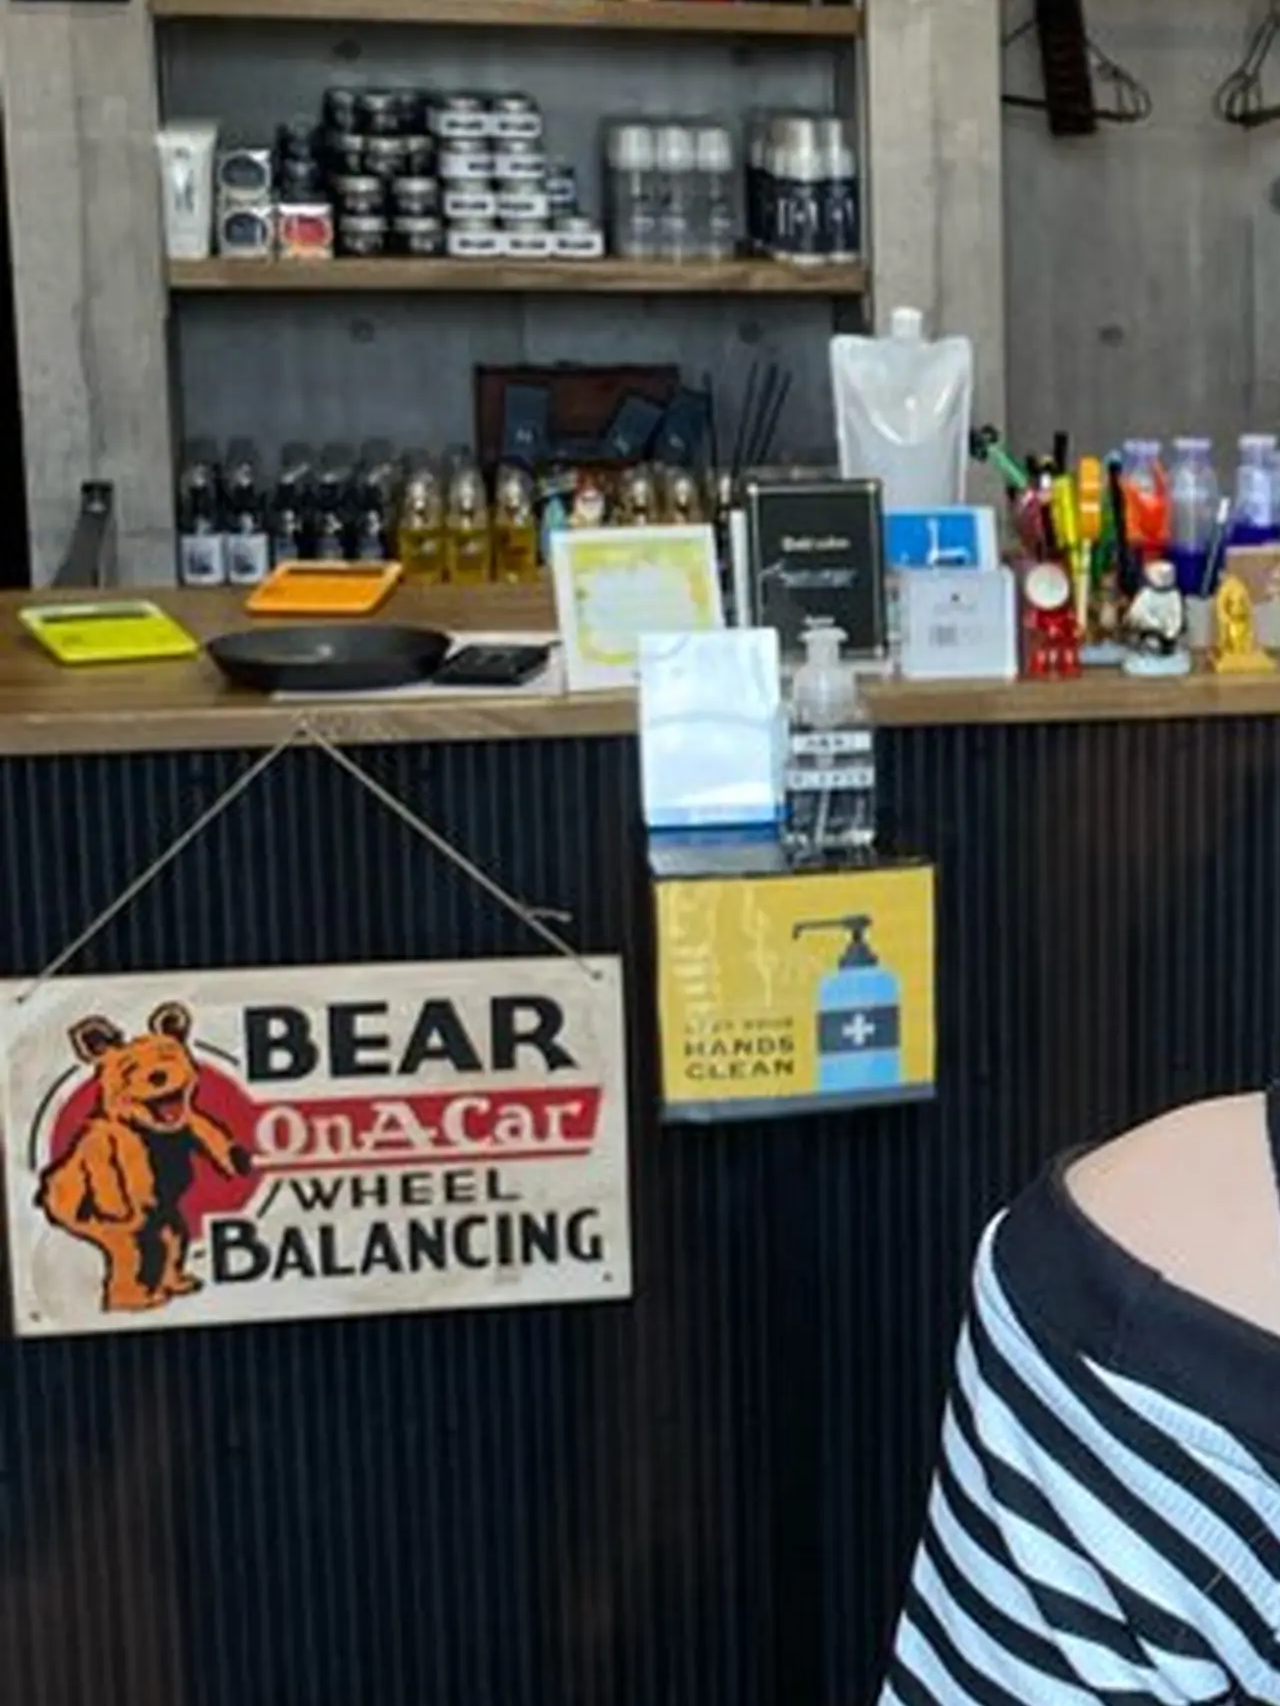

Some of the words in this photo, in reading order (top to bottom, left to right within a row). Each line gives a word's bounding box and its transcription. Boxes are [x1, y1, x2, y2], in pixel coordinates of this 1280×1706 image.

[244, 995, 578, 1083] BEAR
[684, 1035, 795, 1057] HANDS
[684, 1058, 795, 1080] CLEAN
[289, 1167, 524, 1212] WHEEL
[210, 1207, 603, 1285] BALANCING
